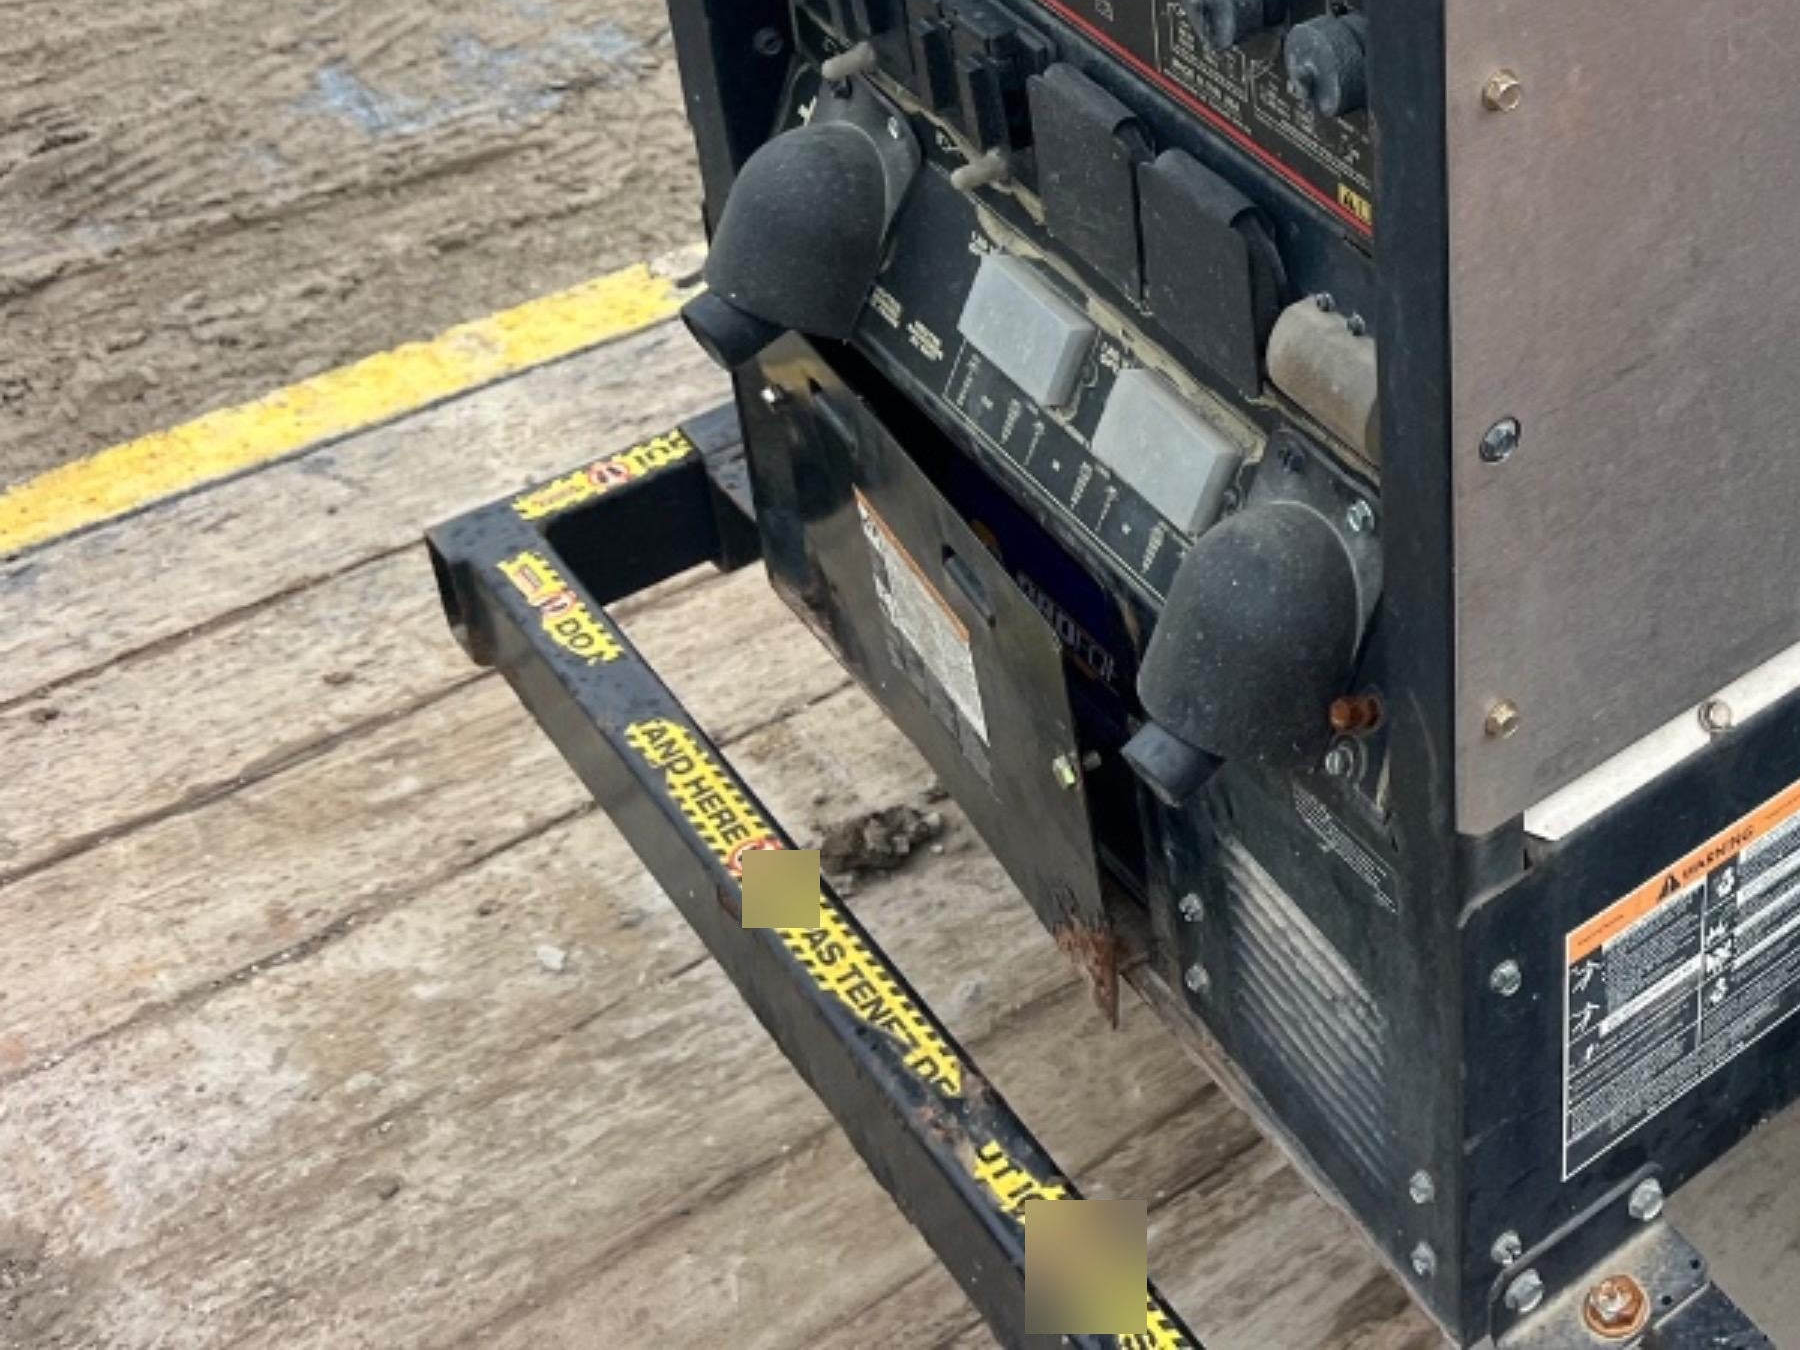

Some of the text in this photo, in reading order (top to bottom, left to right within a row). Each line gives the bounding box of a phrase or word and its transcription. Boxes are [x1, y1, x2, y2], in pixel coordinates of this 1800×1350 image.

[555, 617, 595, 650] DO
[683, 776, 750, 844] HERE
[1682, 825, 1754, 879] WARNING
[801, 928, 846, 967] AS
